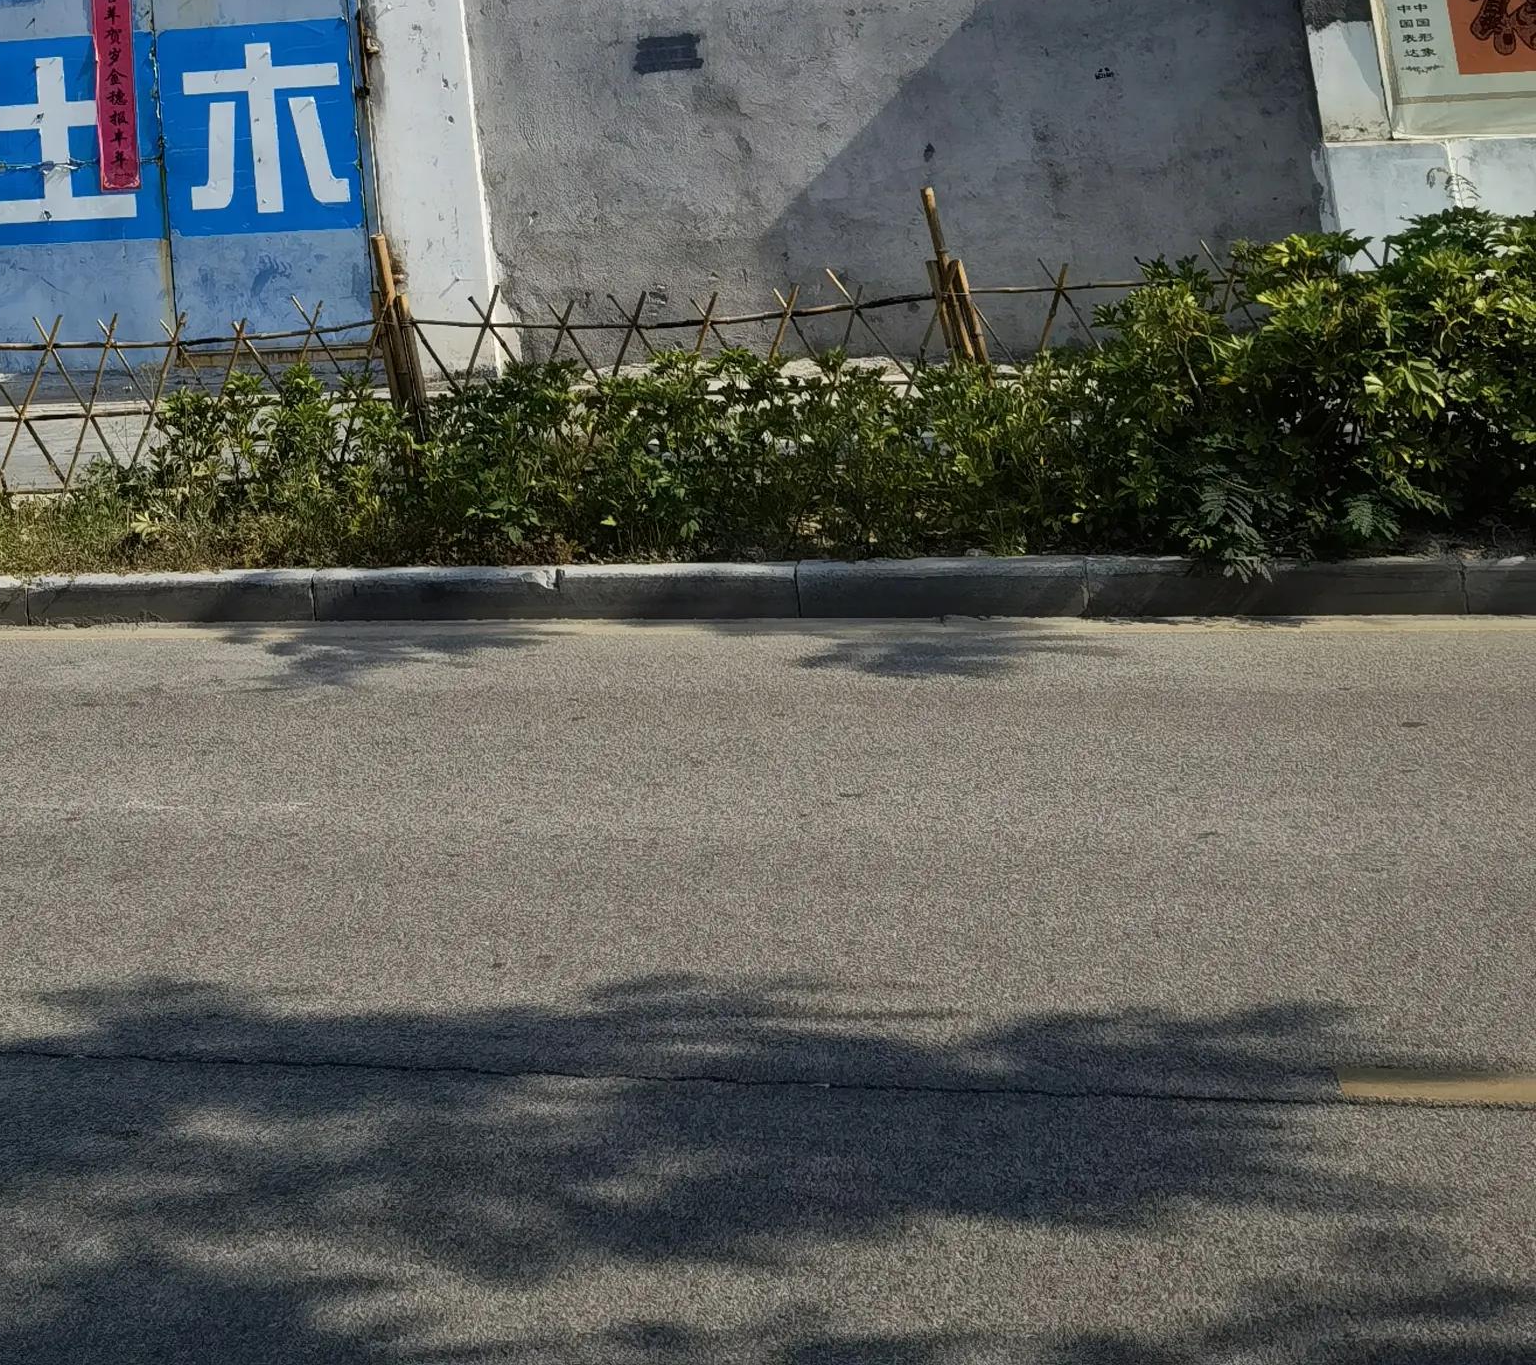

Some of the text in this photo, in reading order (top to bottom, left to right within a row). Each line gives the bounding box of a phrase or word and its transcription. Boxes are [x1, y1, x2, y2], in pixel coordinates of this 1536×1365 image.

[1396, 4, 1421, 57] 中国表达
[1413, 3, 1437, 57] 中国形象
